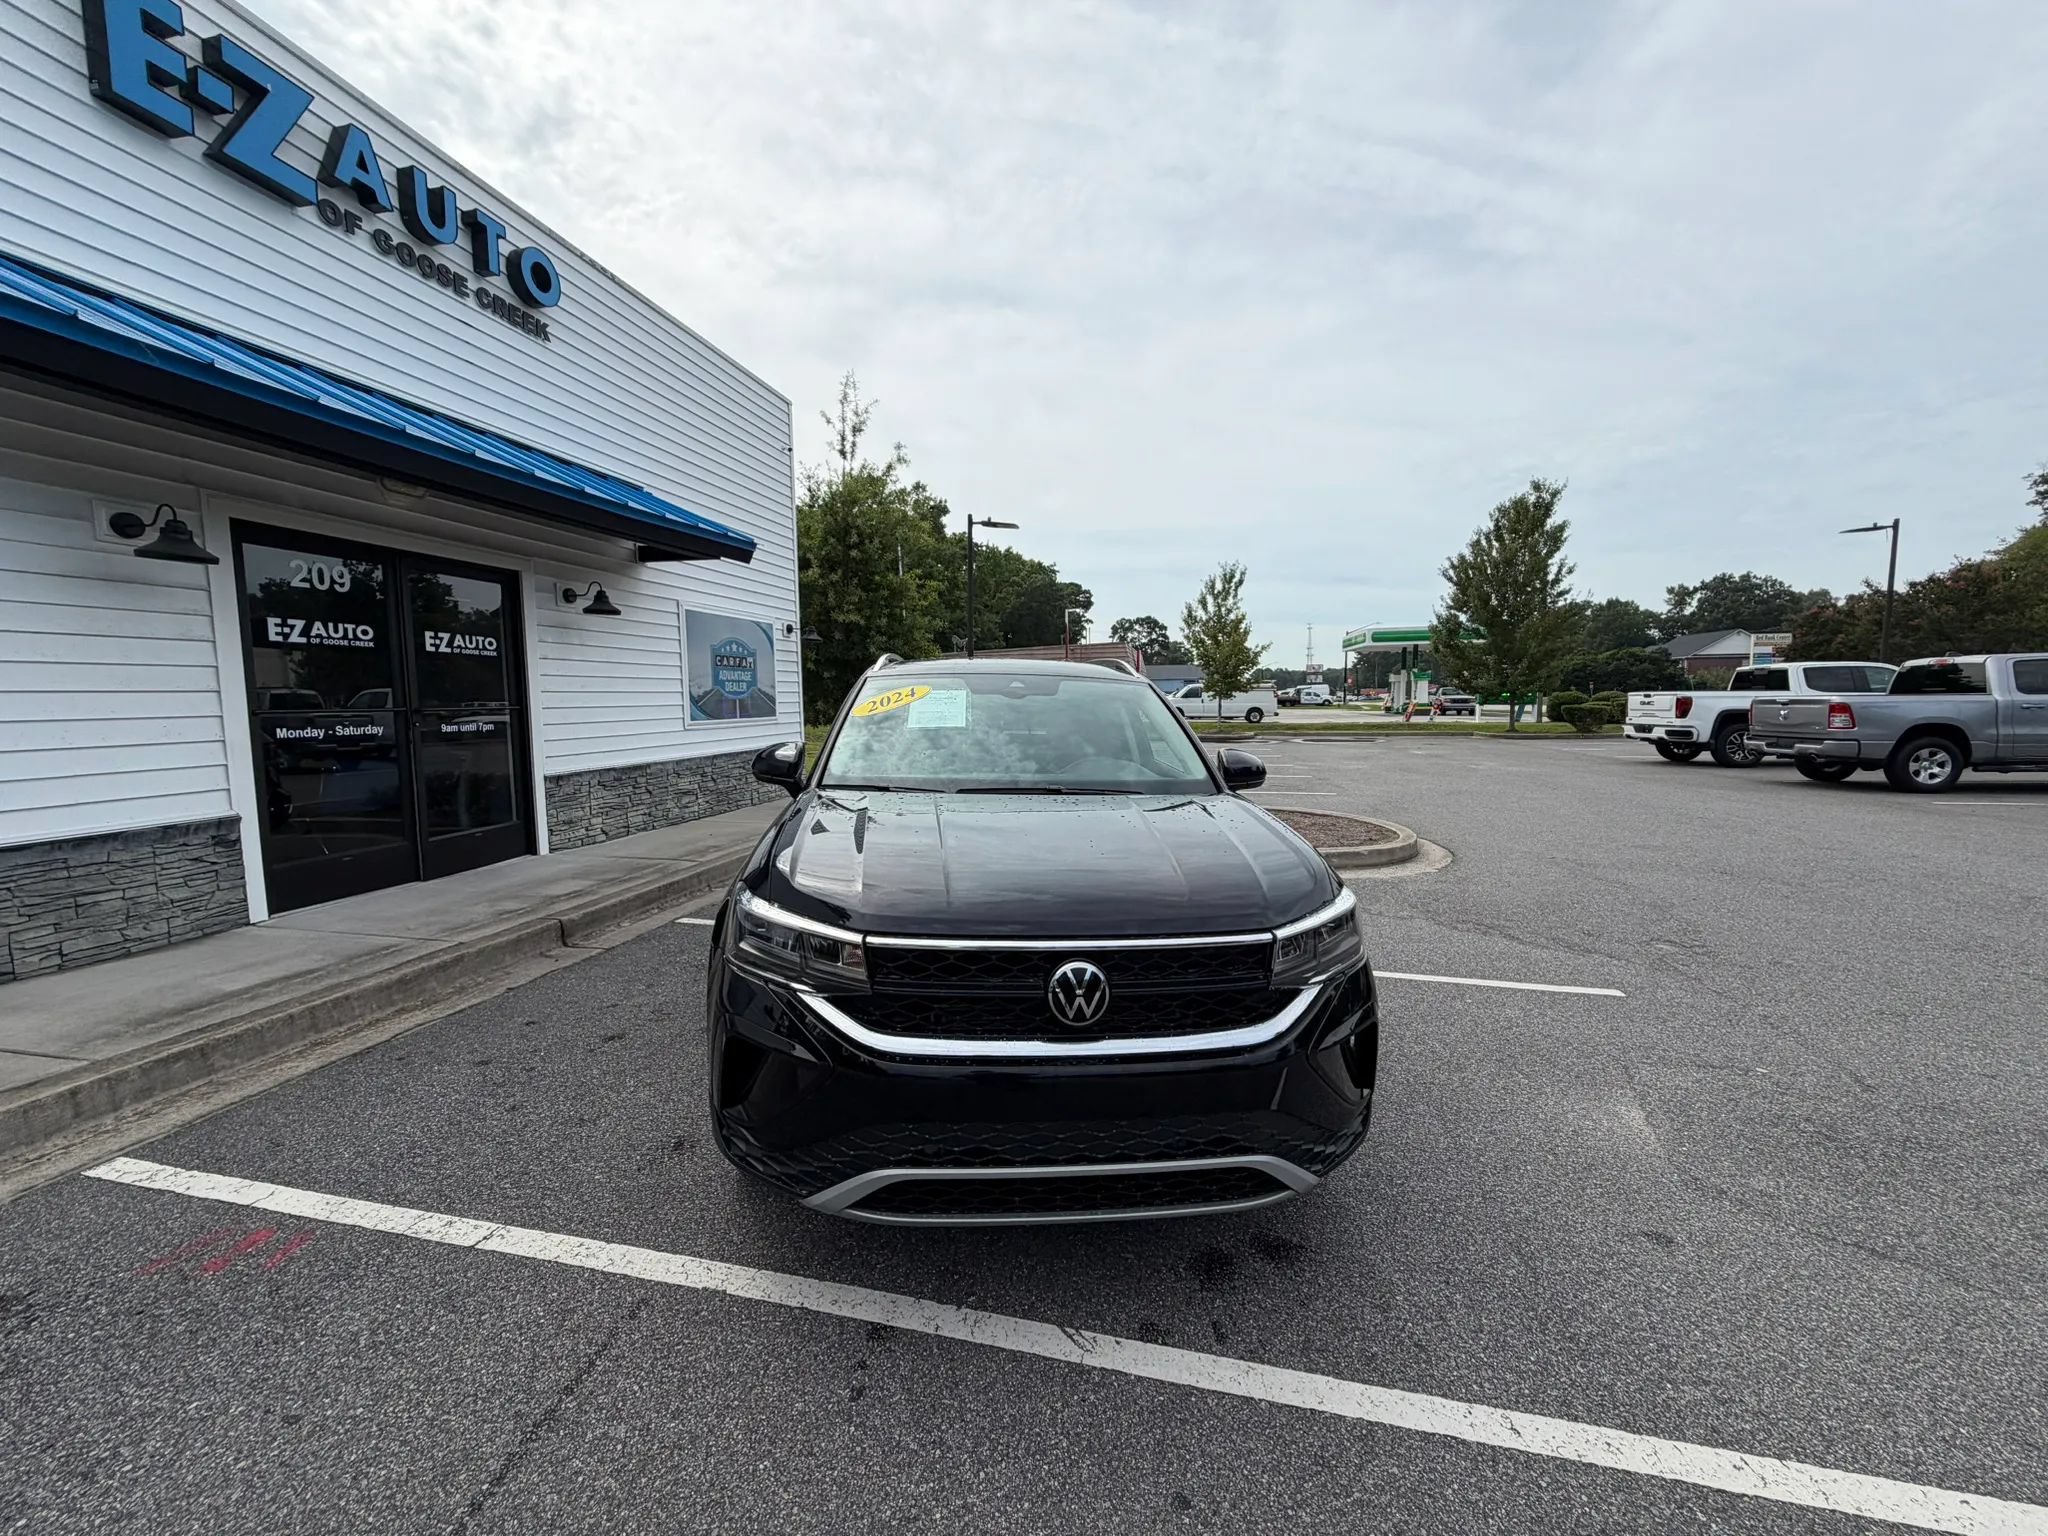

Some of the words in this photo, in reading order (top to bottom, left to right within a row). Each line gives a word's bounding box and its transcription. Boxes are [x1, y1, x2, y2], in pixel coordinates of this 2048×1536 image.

[83, 0, 318, 207] E-Z
[317, 123, 562, 308] AUTO
[317, 198, 363, 236] OF
[372, 228, 470, 299] GOOSE
[475, 286, 552, 343] CREEK
[289, 559, 350, 593] 209
[266, 617, 308, 643] E-Z
[310, 621, 374, 640] AUTO
[322, 638, 349, 646] GOOSE
[350, 640, 375, 648] CREEK
[424, 631, 452, 653] E-Z
[453, 634, 497, 650] AUTO
[716, 655, 754, 669] CARFAX
[719, 670, 753, 681] ADVANTAGE
[725, 682, 748, 692] DEALER
[866, 687, 917, 713] 2024
[276, 727, 325, 740] Monday
[335, 724, 384, 737] Saturday
[441, 723, 458, 733] 9am
[460, 722, 477, 732] until
[478, 722, 495, 732] 7pm
